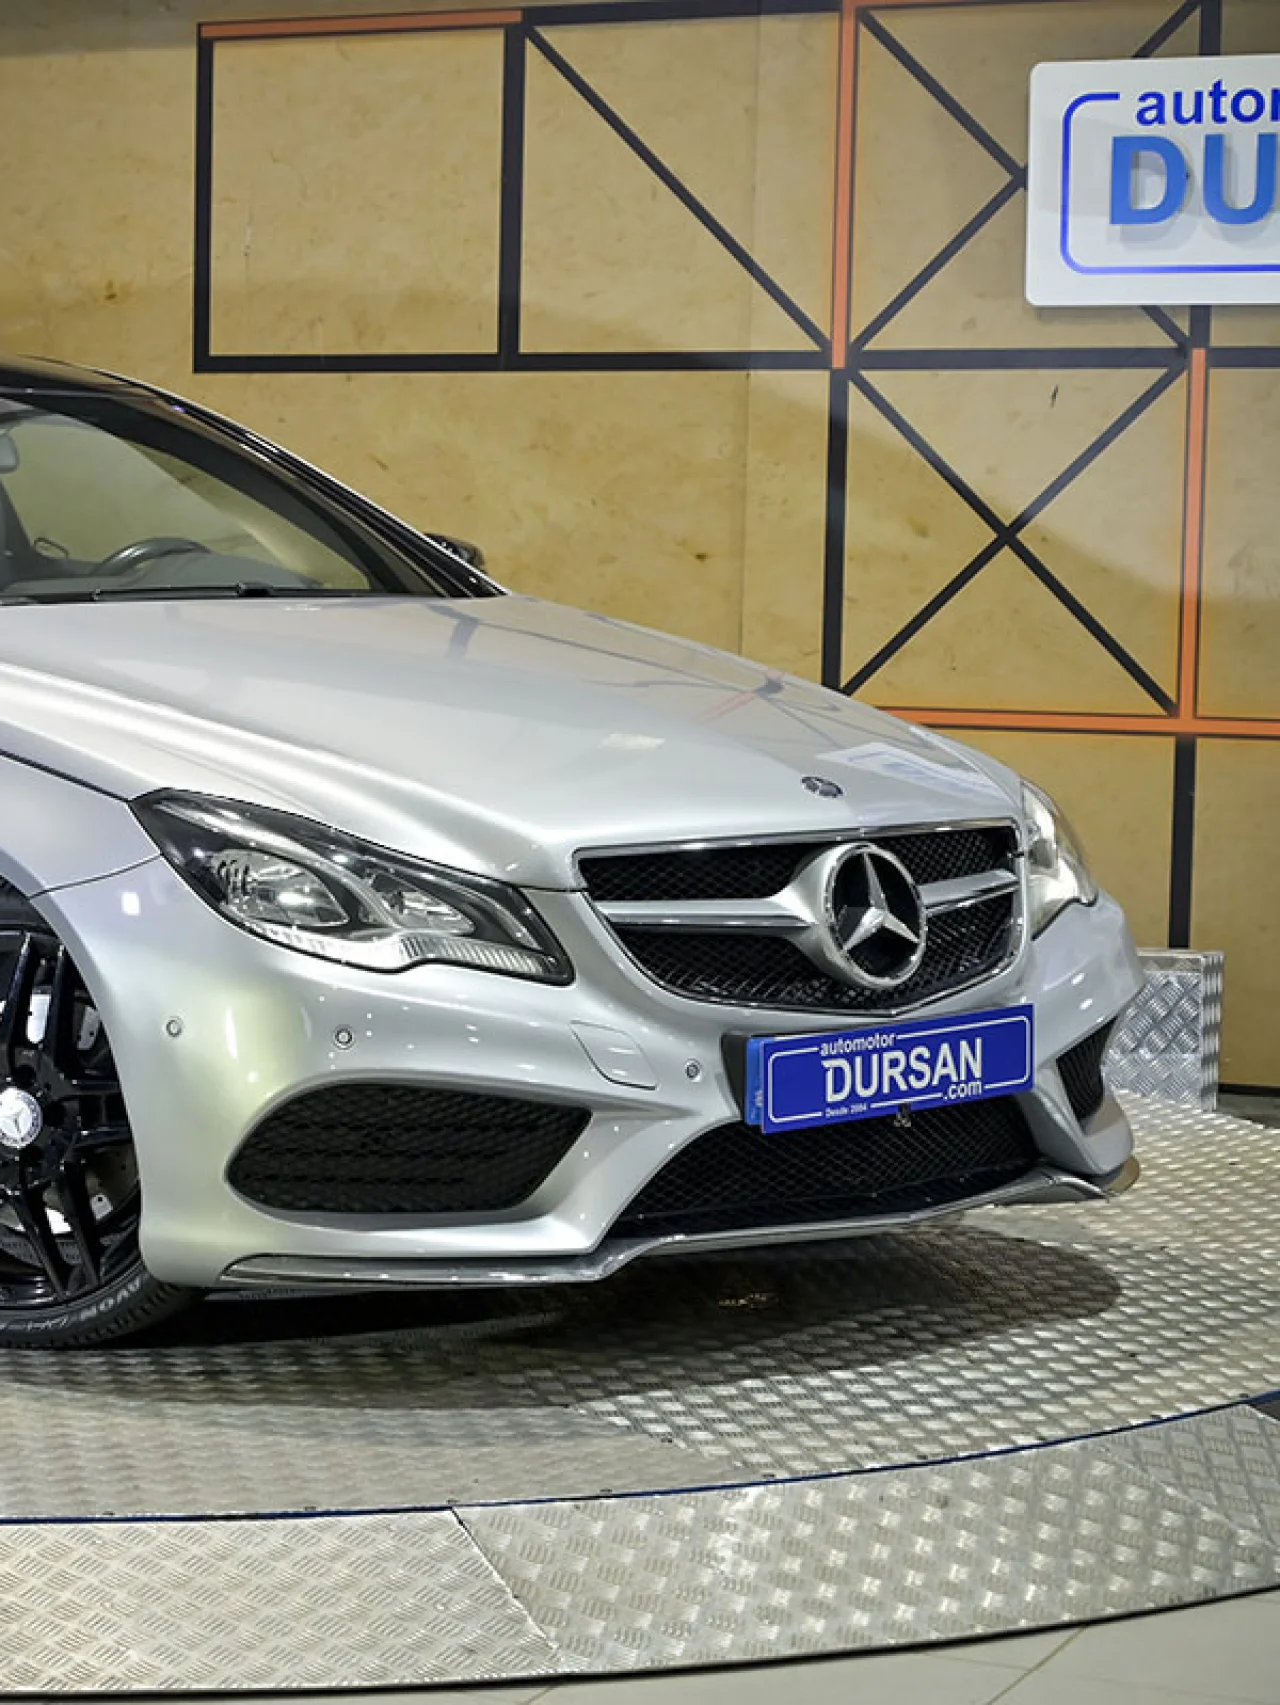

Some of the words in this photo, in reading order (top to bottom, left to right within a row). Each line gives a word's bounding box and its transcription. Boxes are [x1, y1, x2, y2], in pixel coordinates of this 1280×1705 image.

[1135, 78, 1280, 126] auto
[1109, 133, 1278, 225] DU
[821, 1032, 897, 1056] automotor
[821, 1037, 983, 1104] DURSAN
